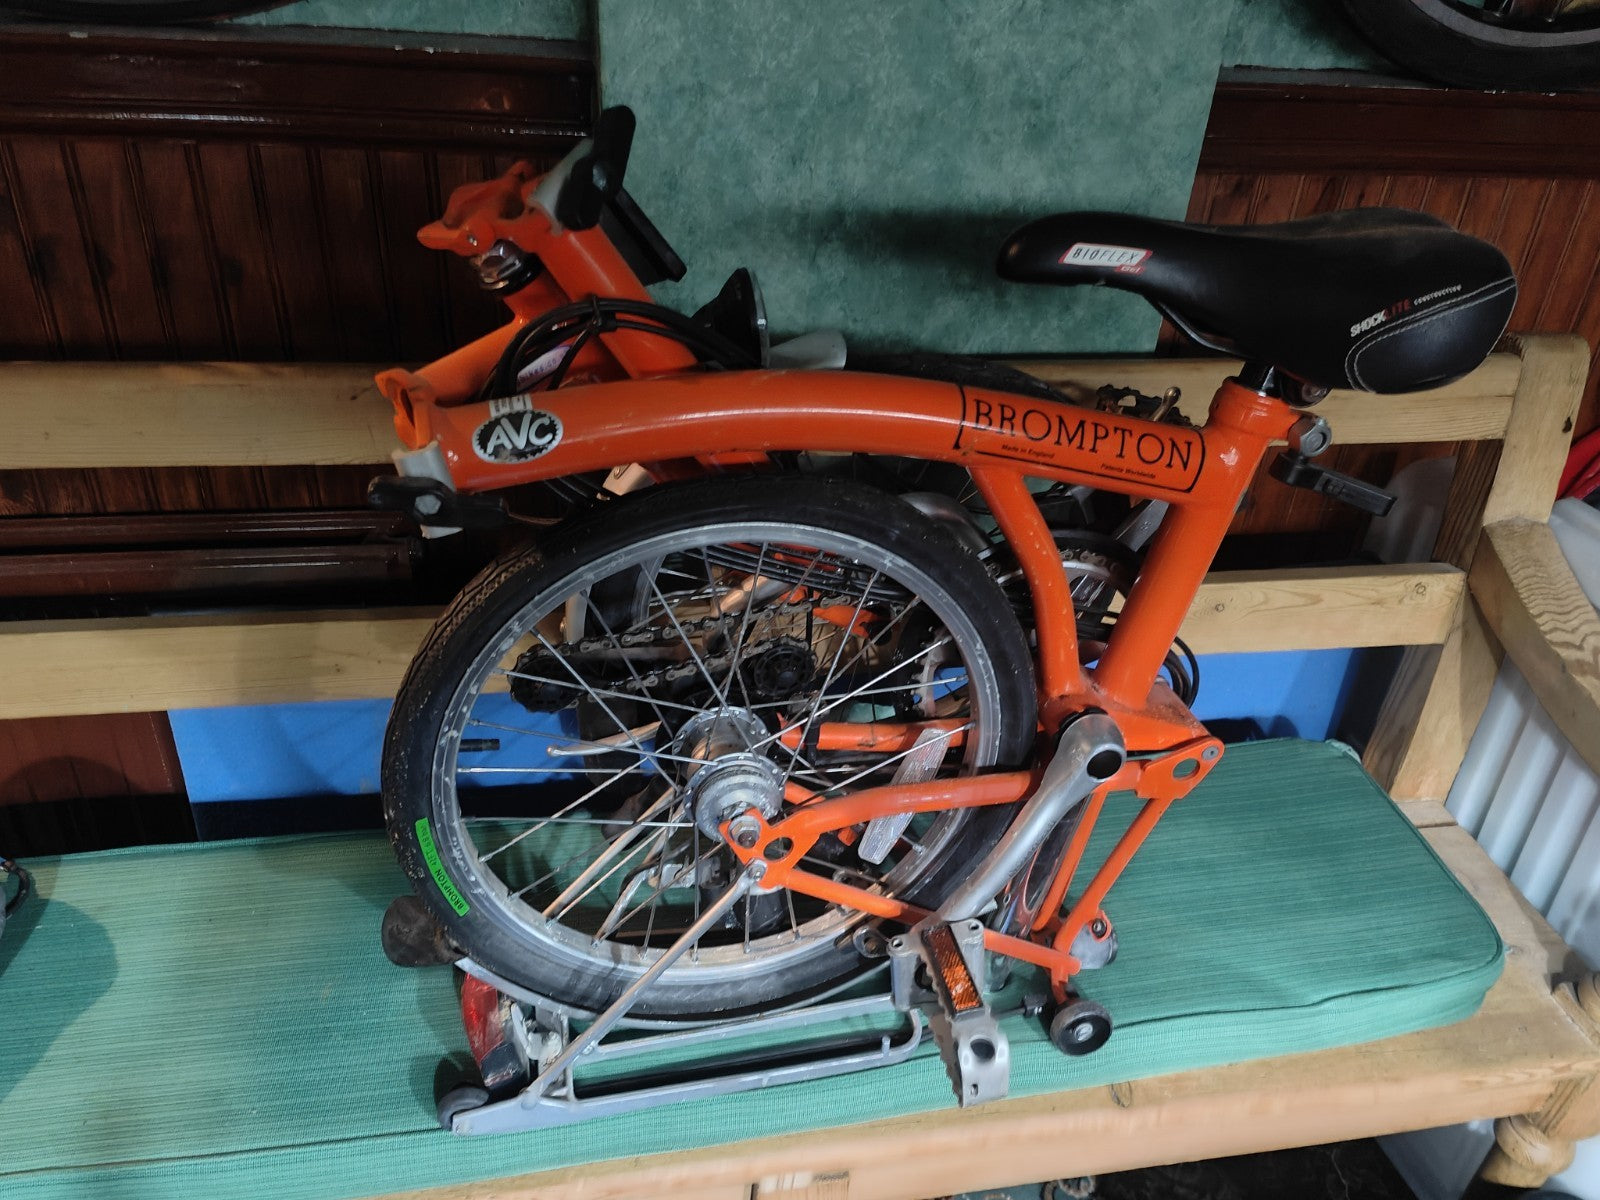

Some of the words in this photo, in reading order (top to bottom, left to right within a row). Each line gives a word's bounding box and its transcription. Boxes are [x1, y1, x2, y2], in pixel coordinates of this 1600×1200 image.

[1072, 247, 1139, 264] BIOFLEX
[486, 412, 554, 455] AVC
[973, 398, 1193, 472] BROMPTON
[434, 868, 465, 910] BROMPTON
